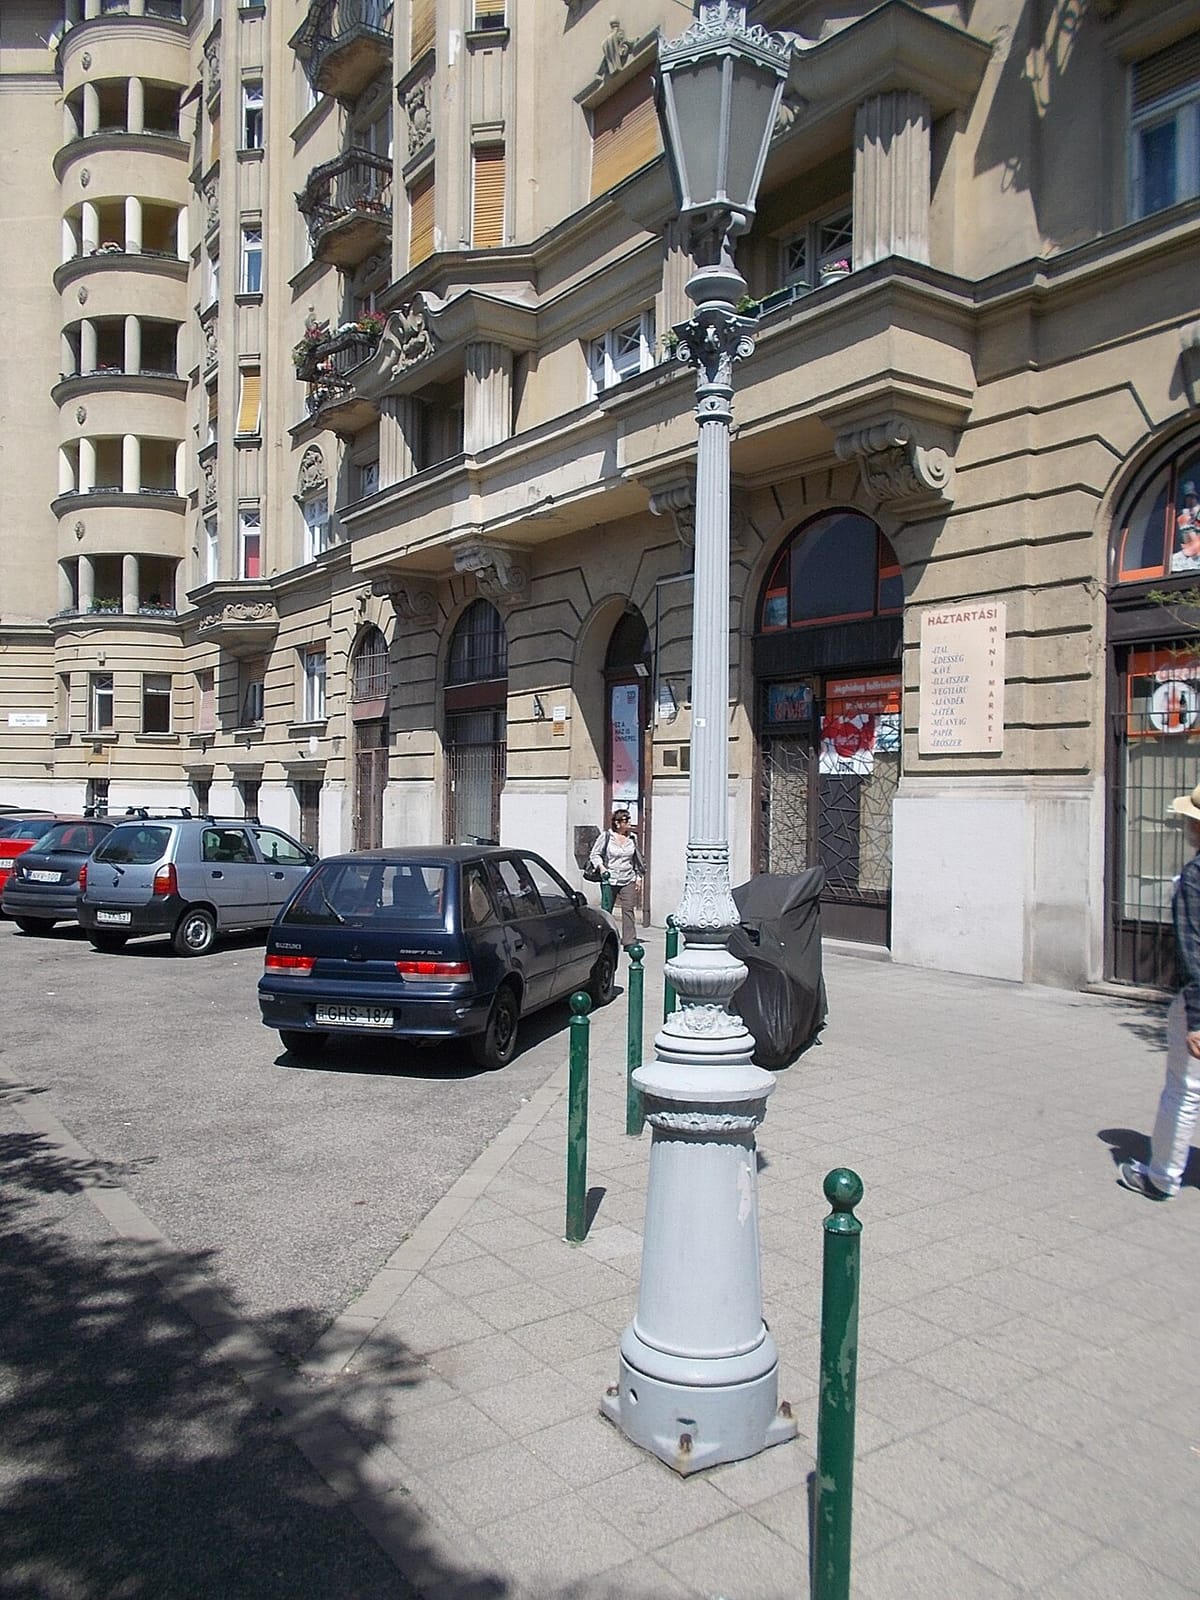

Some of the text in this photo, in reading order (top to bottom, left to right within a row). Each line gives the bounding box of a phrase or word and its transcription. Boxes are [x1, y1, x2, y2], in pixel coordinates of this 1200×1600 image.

[927, 608, 997, 626] HÁZTARTÁSI
[988, 625, 997, 667] MINI
[987, 679, 996, 744] MARKET
[328, 1006, 390, 1023] GHS-187
